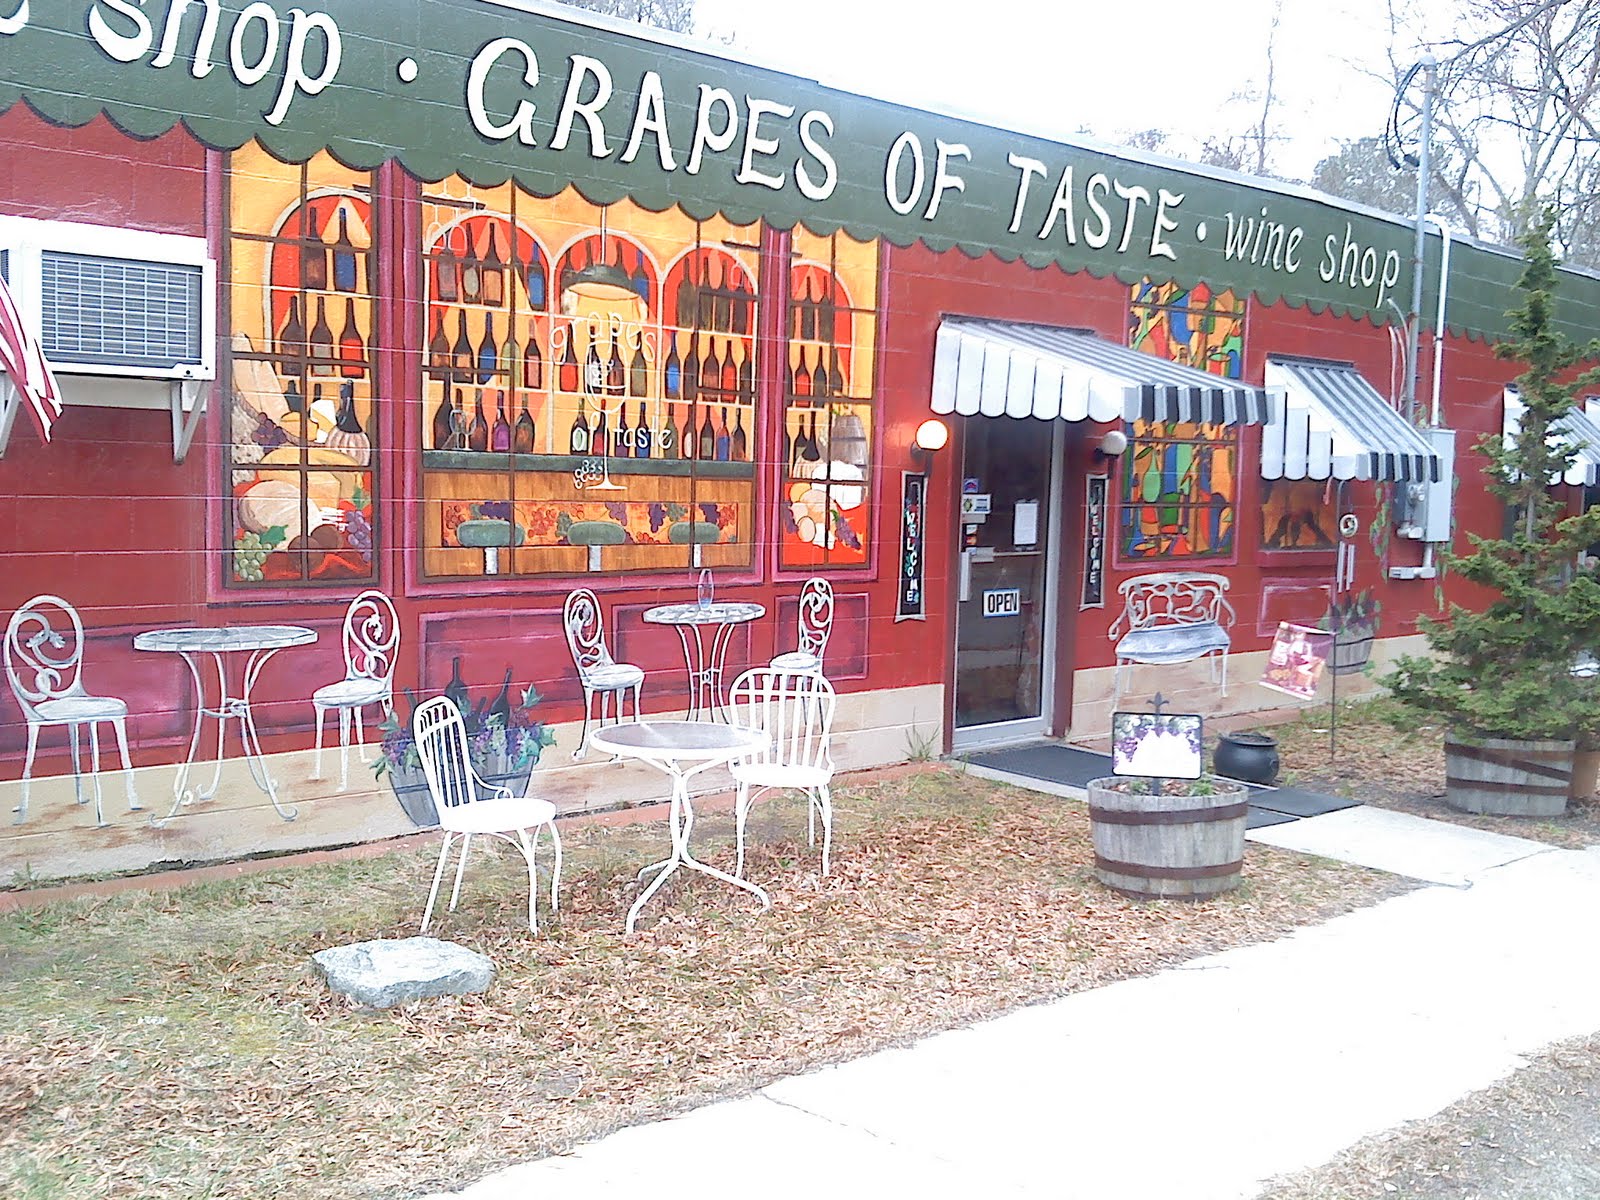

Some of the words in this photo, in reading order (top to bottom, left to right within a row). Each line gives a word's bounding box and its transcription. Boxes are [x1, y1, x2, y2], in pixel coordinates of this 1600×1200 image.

[466, 36, 838, 201] GRAPES
[885, 130, 973, 220] OF
[1007, 151, 1186, 261] TASTE
[1224, 206, 1304, 273] wine
[1319, 221, 1401, 309] shop
[550, 311, 656, 365] grapes
[572, 411, 601, 453] of
[613, 415, 673, 449] taste
[905, 510, 919, 602] WELCOME
[1089, 503, 1100, 584] WELCOME
[987, 593, 1018, 613] OPEN
